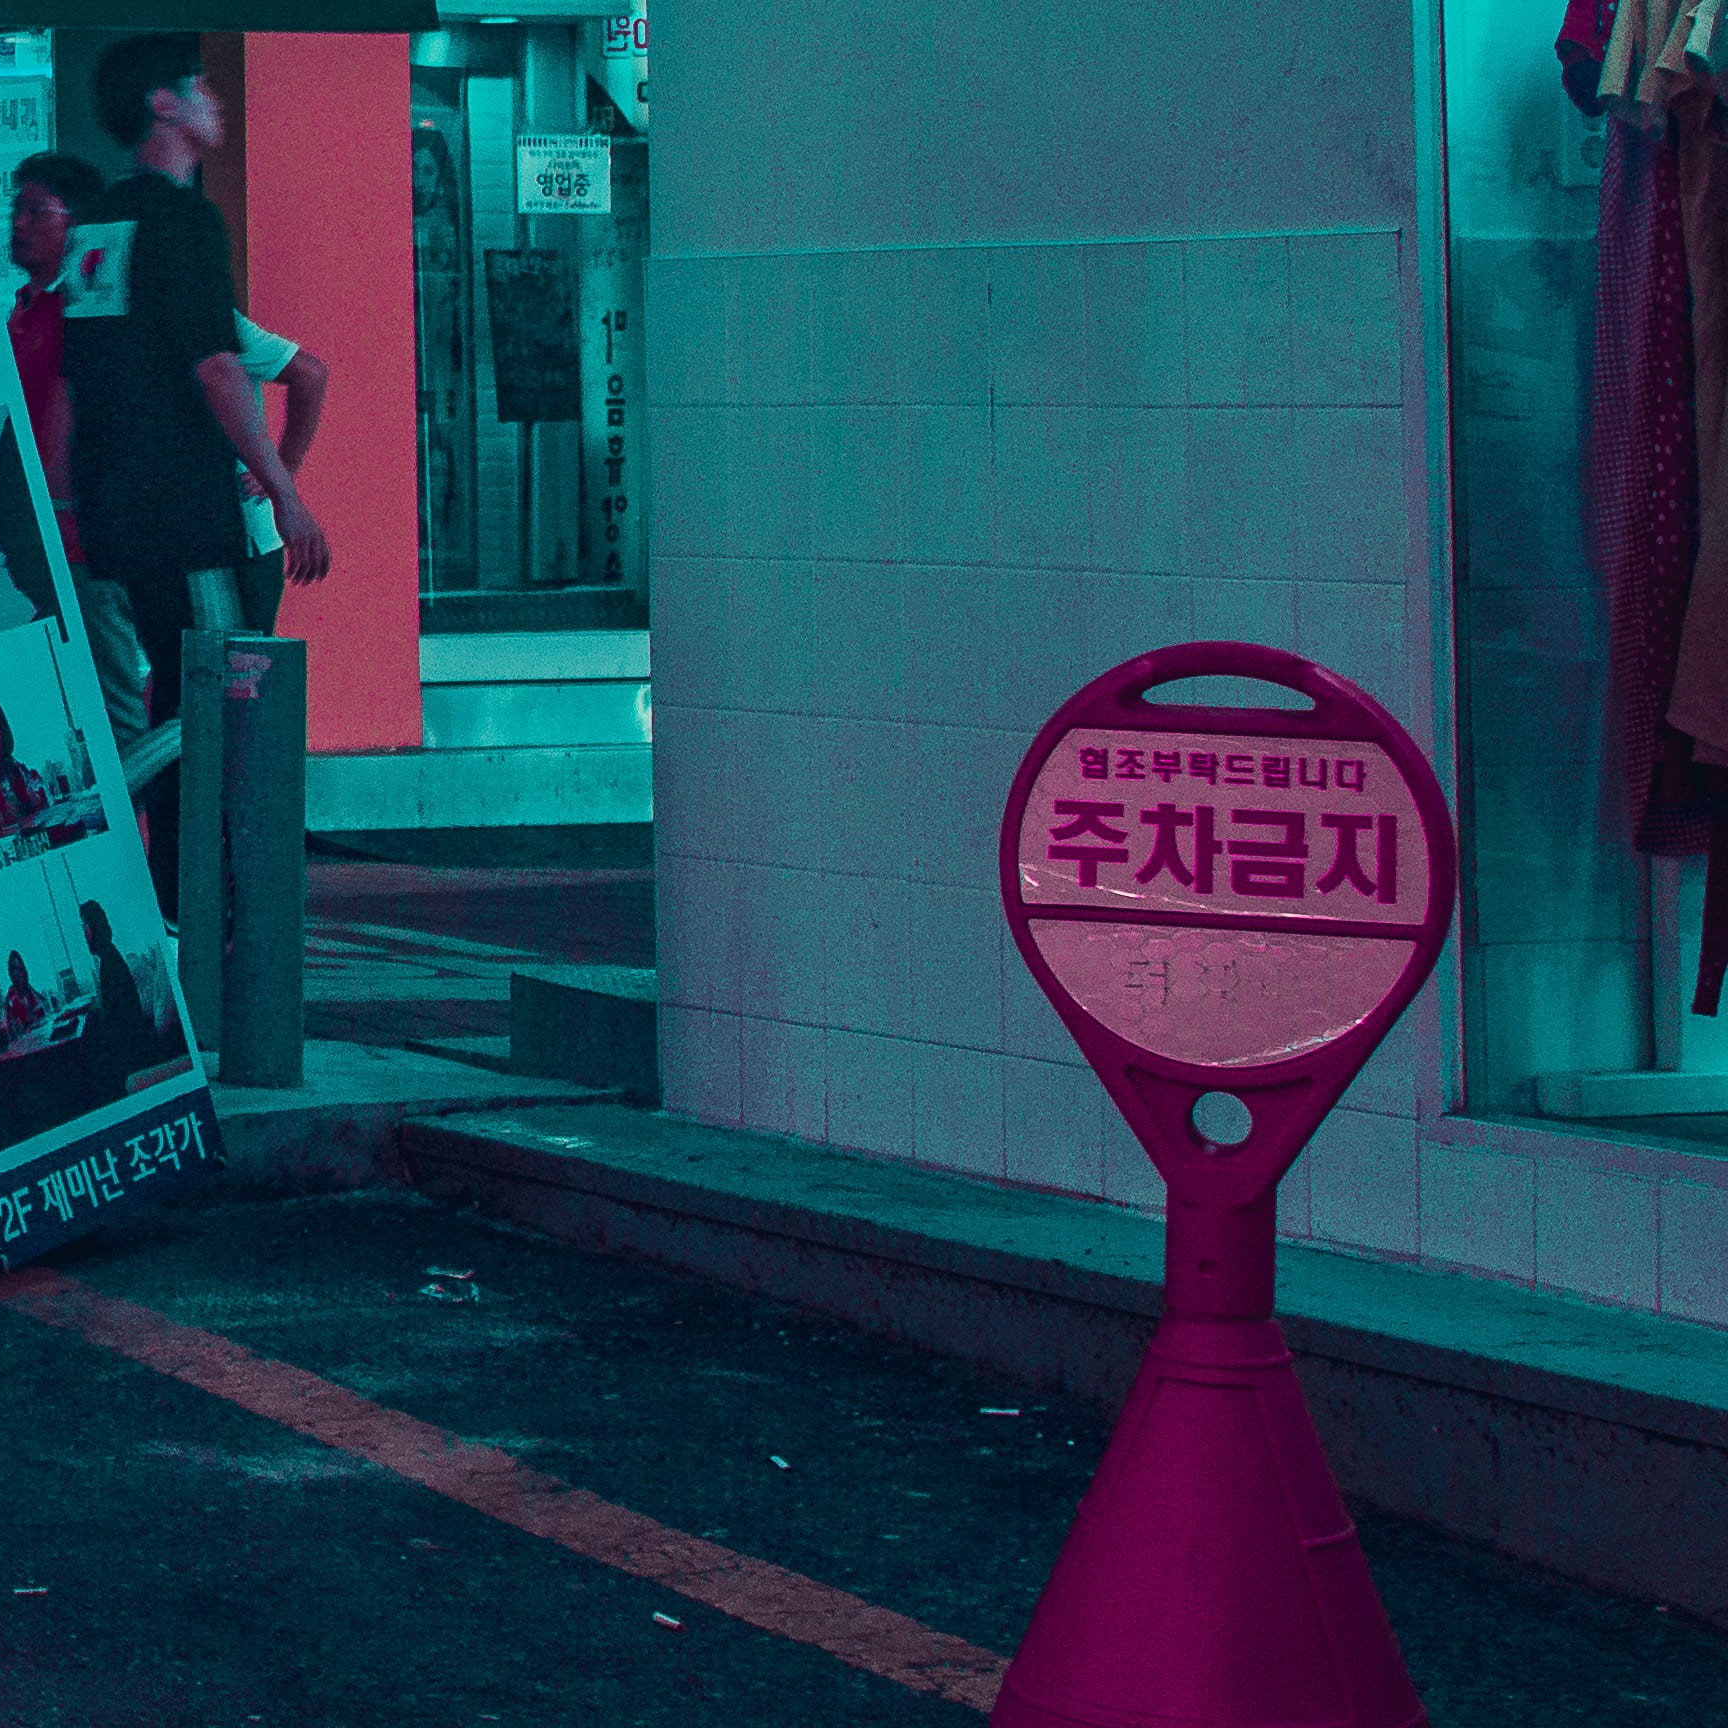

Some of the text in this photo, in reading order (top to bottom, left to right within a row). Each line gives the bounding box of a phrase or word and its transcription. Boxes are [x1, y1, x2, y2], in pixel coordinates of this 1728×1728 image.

[535, 172, 592, 198] 영업중
[1047, 798, 1398, 905] 주차금지
[40, 1166, 126, 1223] 재미난
[127, 1117, 207, 1184] 조각가
